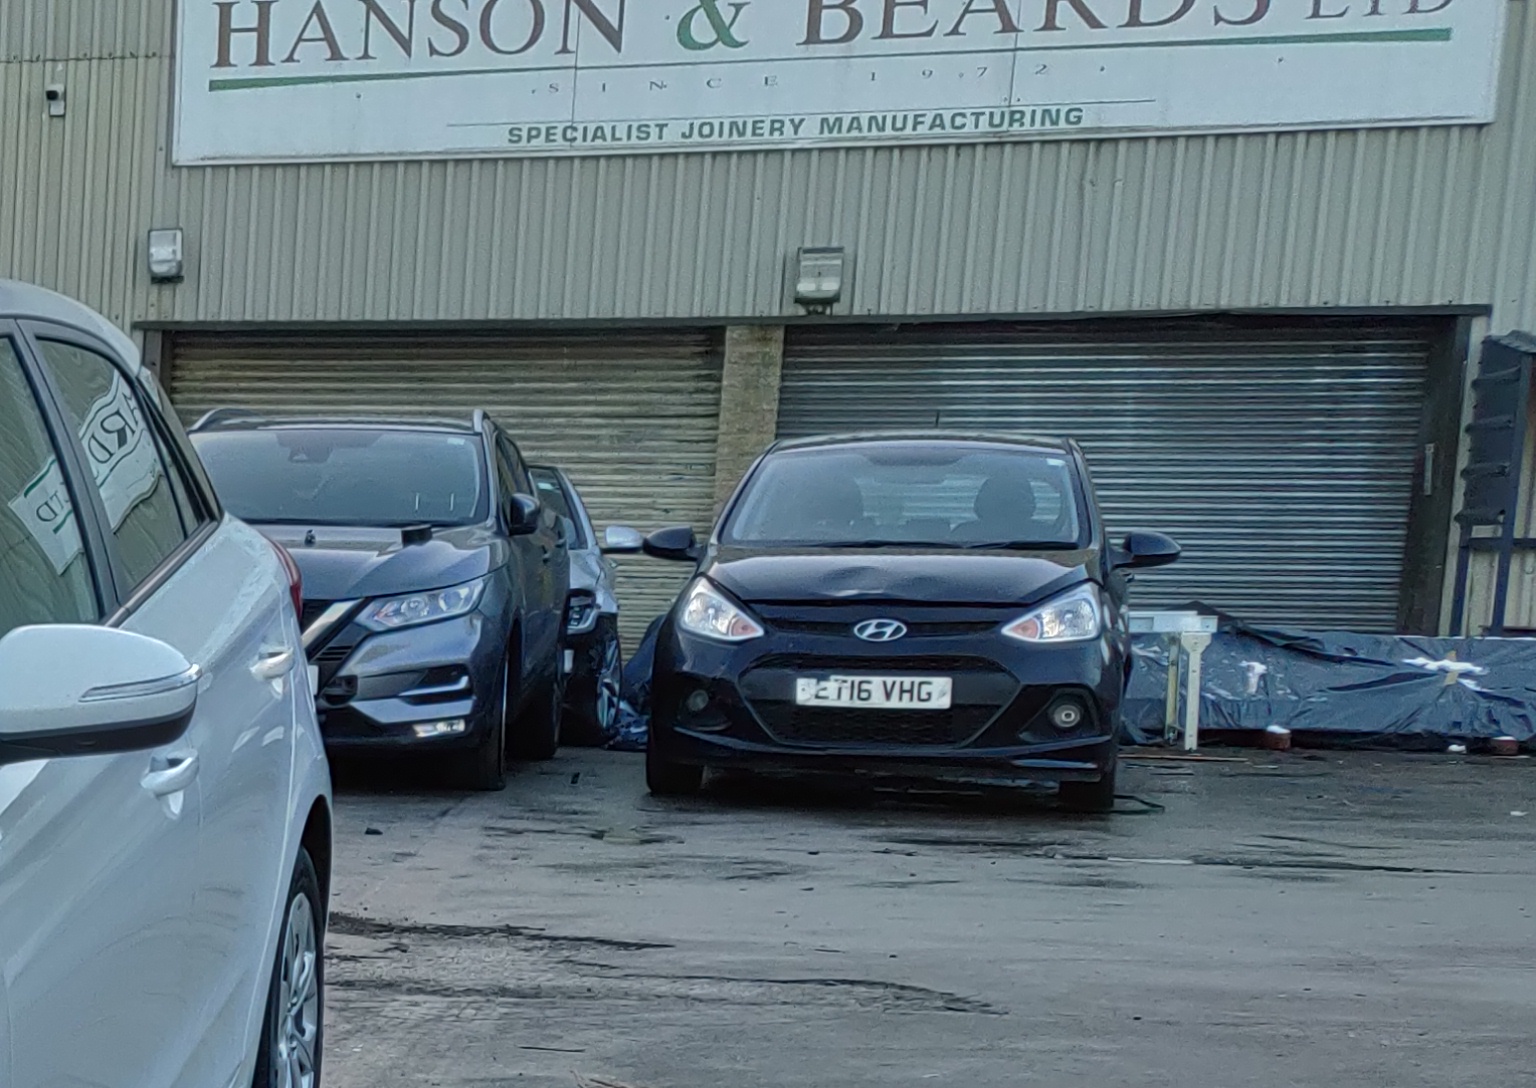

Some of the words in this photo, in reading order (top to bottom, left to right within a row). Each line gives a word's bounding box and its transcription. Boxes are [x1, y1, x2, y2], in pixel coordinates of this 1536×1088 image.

[209, 0, 626, 68] HANSON
[676, 0, 750, 51] &
[870, 63, 1048, 82] 1972
[507, 123, 669, 144] SPECIALIST
[681, 117, 806, 140] JOINERY
[818, 107, 1084, 136] MANUFACTURING
[882, 679, 934, 702] VHG
